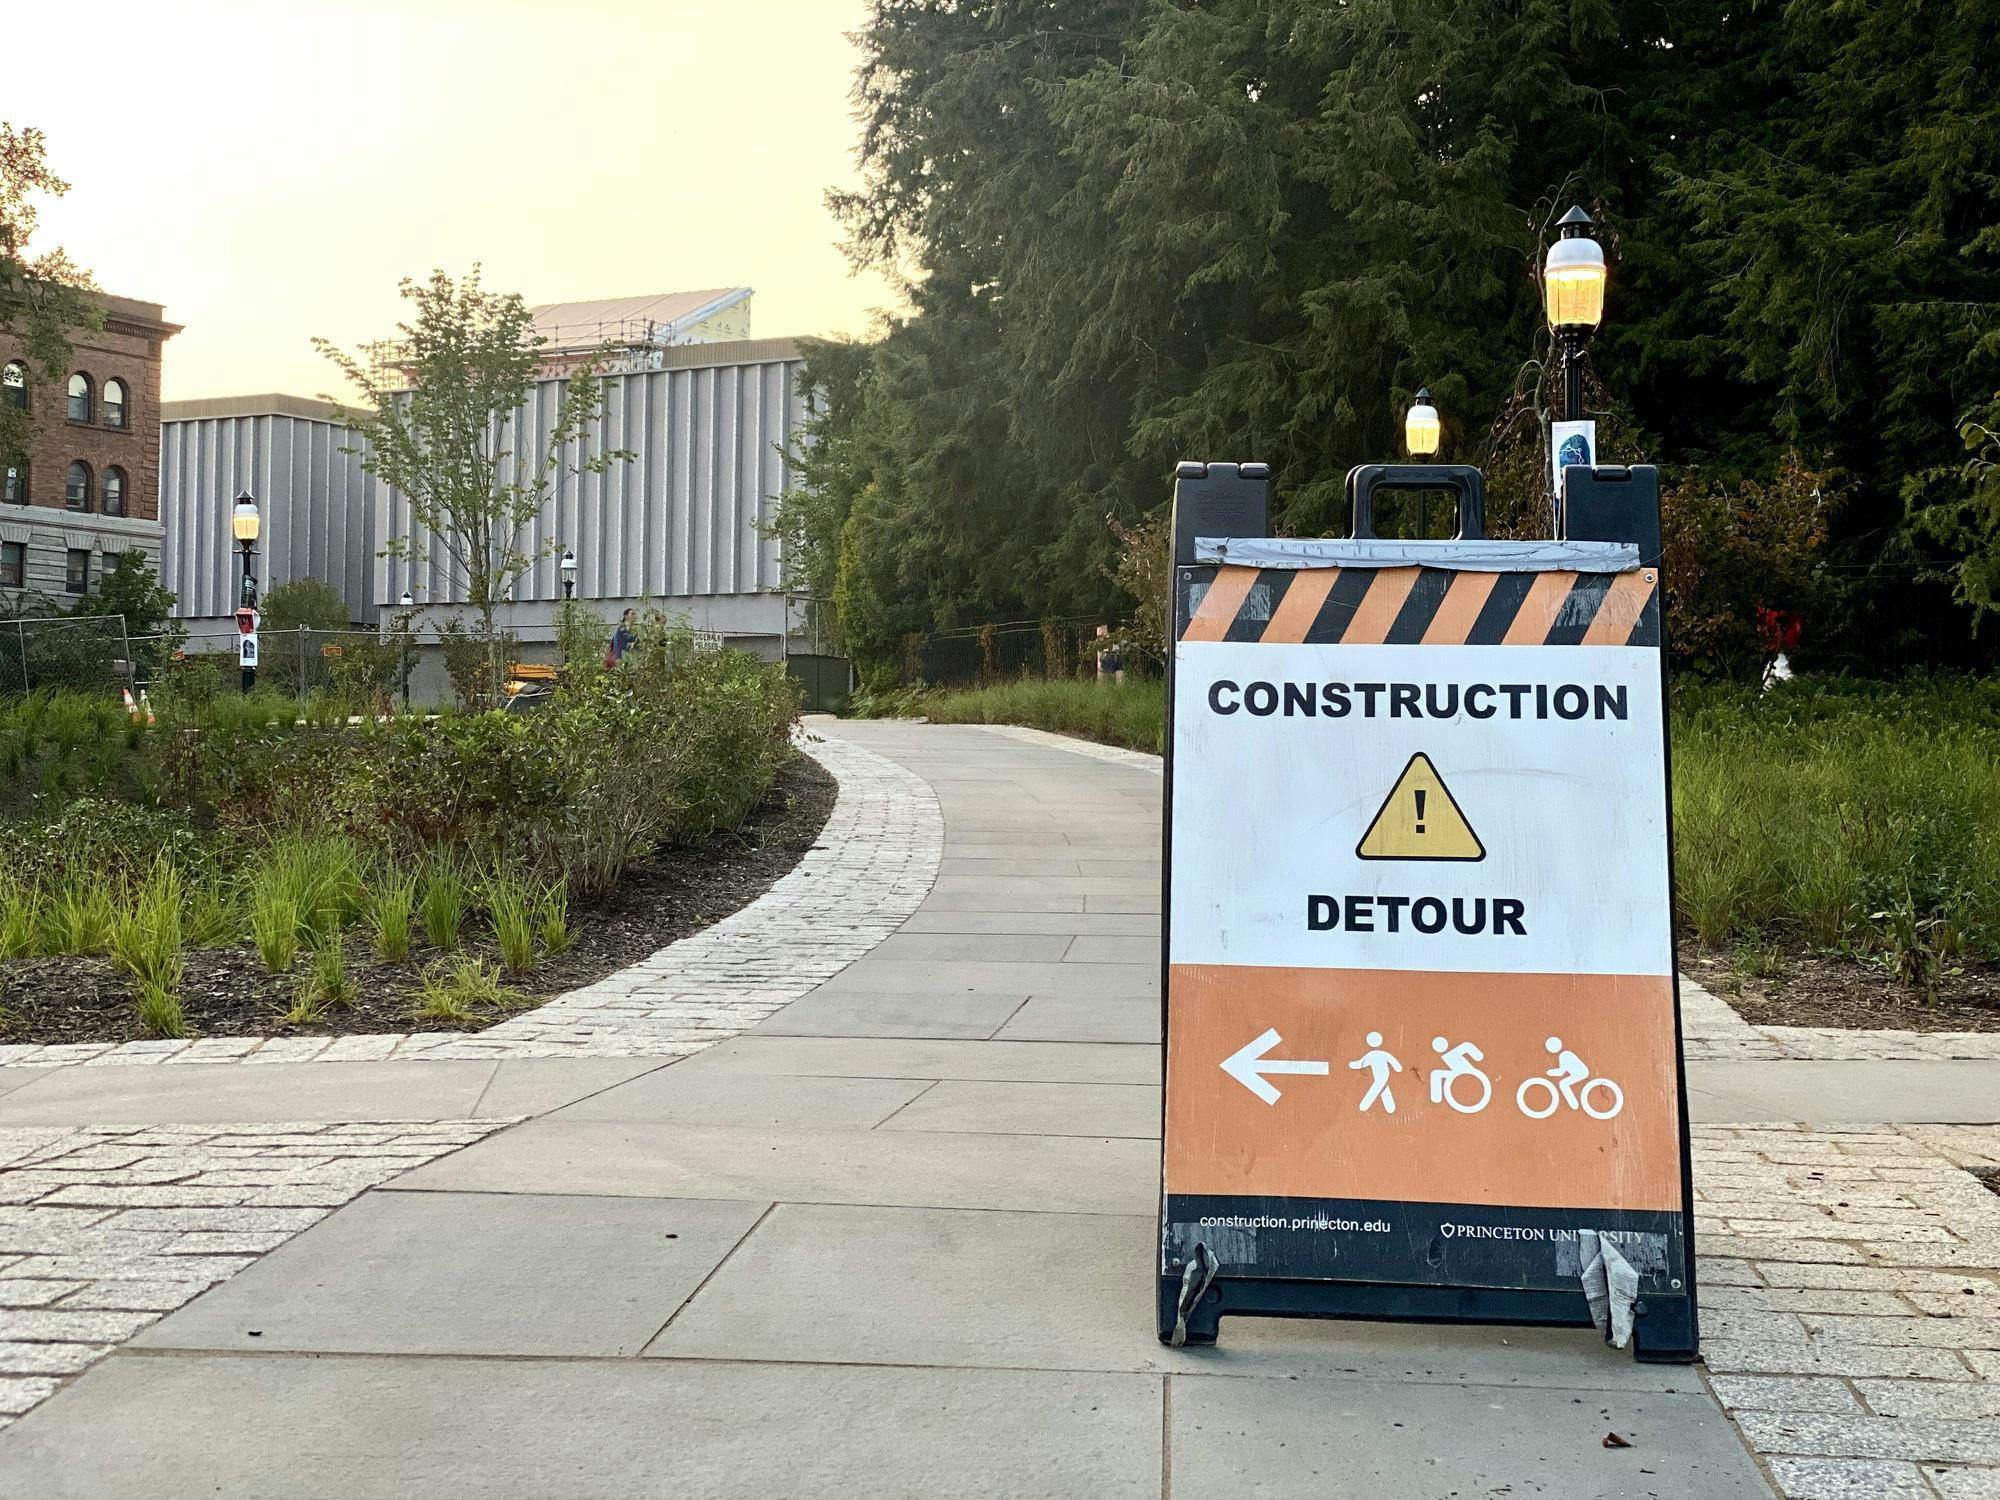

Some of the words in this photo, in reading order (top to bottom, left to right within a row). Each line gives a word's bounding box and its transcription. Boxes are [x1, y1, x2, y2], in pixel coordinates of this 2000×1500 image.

[1207, 679, 1629, 721] CONSTRUCTION
[1307, 893, 1528, 936] DETOUR
[1457, 1224, 1545, 1242] PRINCETON
[1549, 1228, 1645, 1244] UNIRSITY
